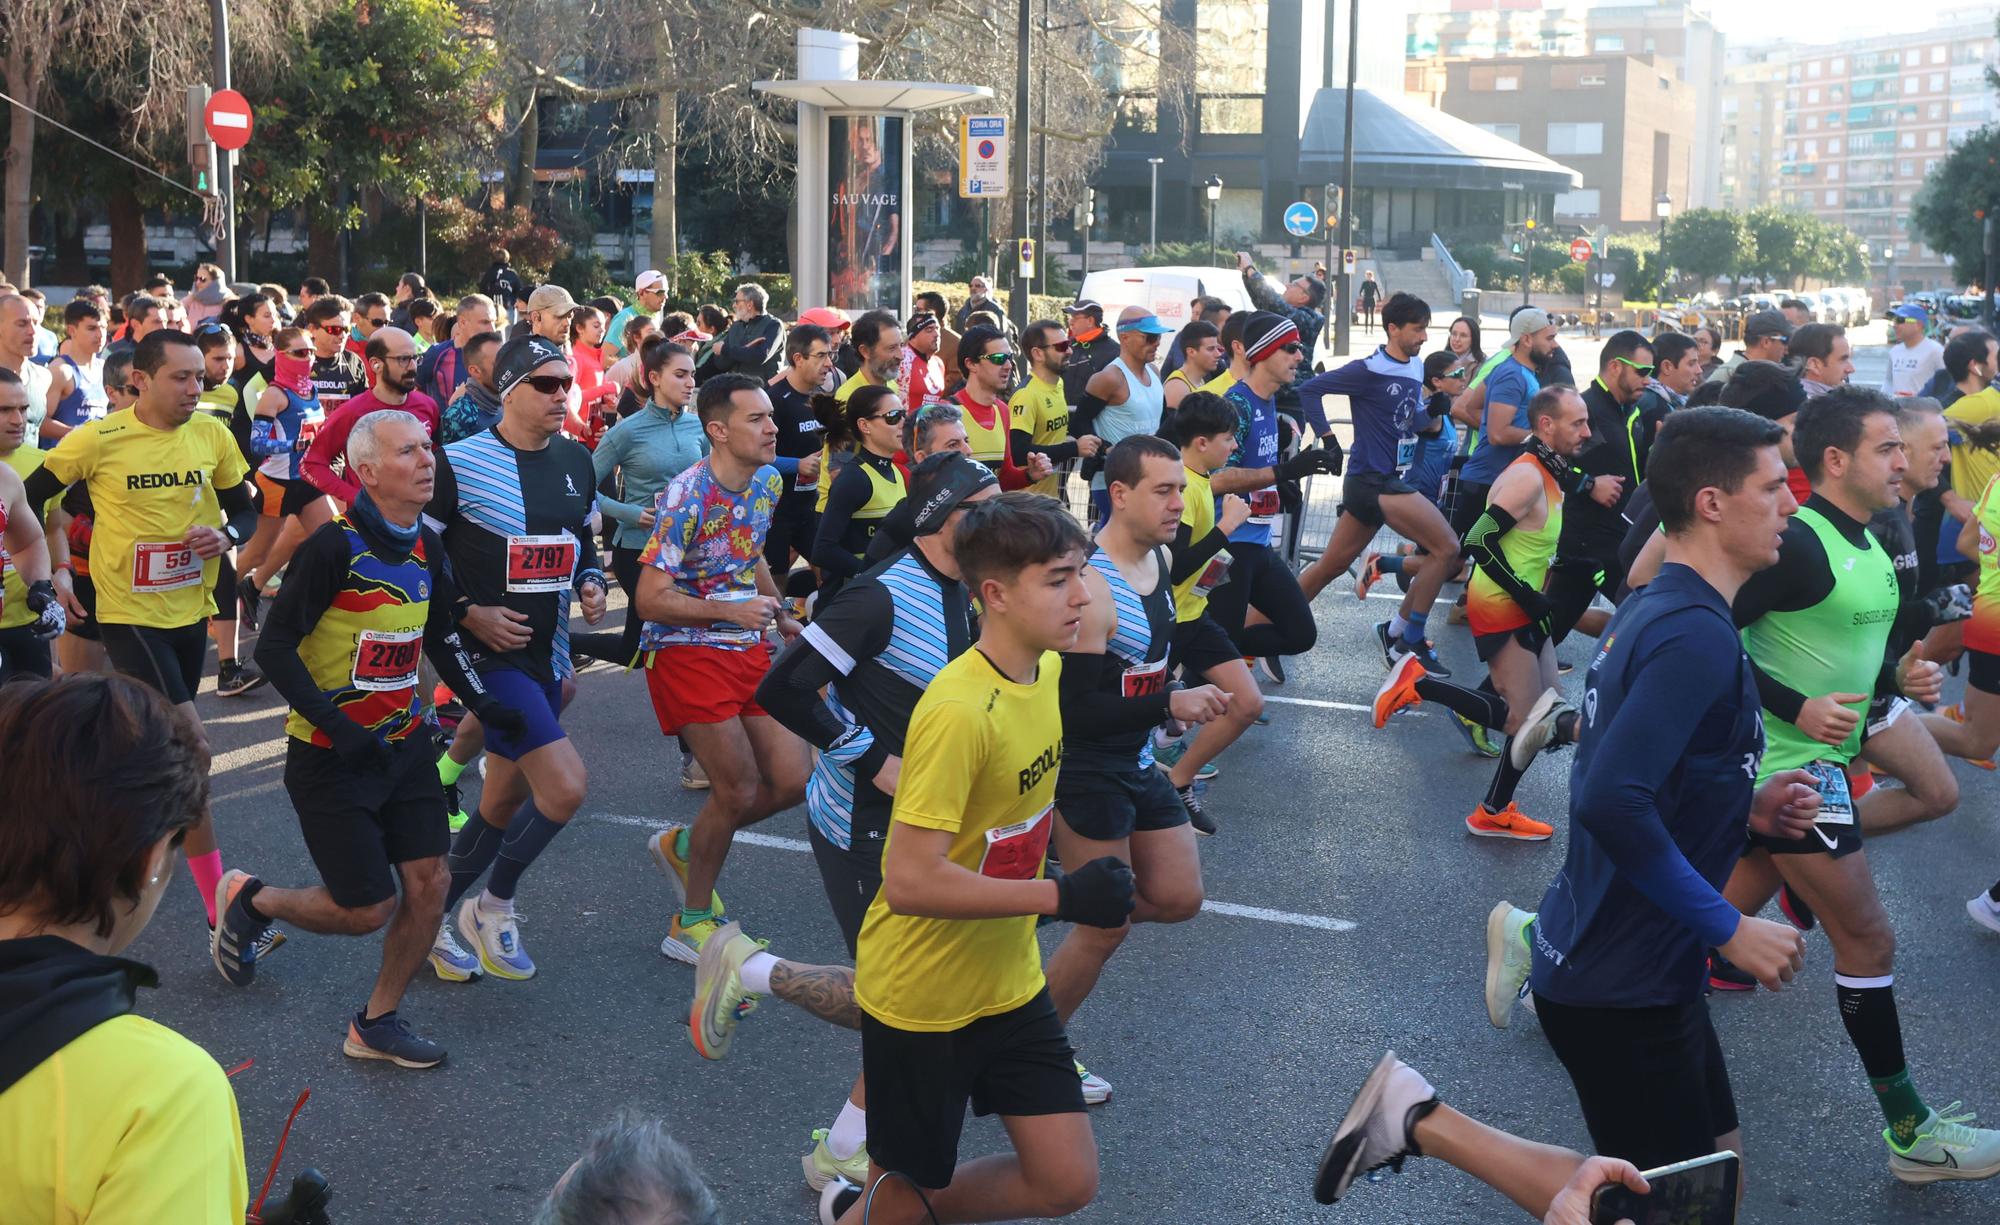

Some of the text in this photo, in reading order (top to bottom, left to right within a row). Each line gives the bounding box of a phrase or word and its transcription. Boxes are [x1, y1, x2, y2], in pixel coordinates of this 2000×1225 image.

[971, 120, 988, 128] ZONA
[833, 193, 897, 206] SAUVAGE
[126, 470, 203, 490] REDOLAT
[165, 550, 192, 570] 59
[521, 546, 565, 569] 2797
